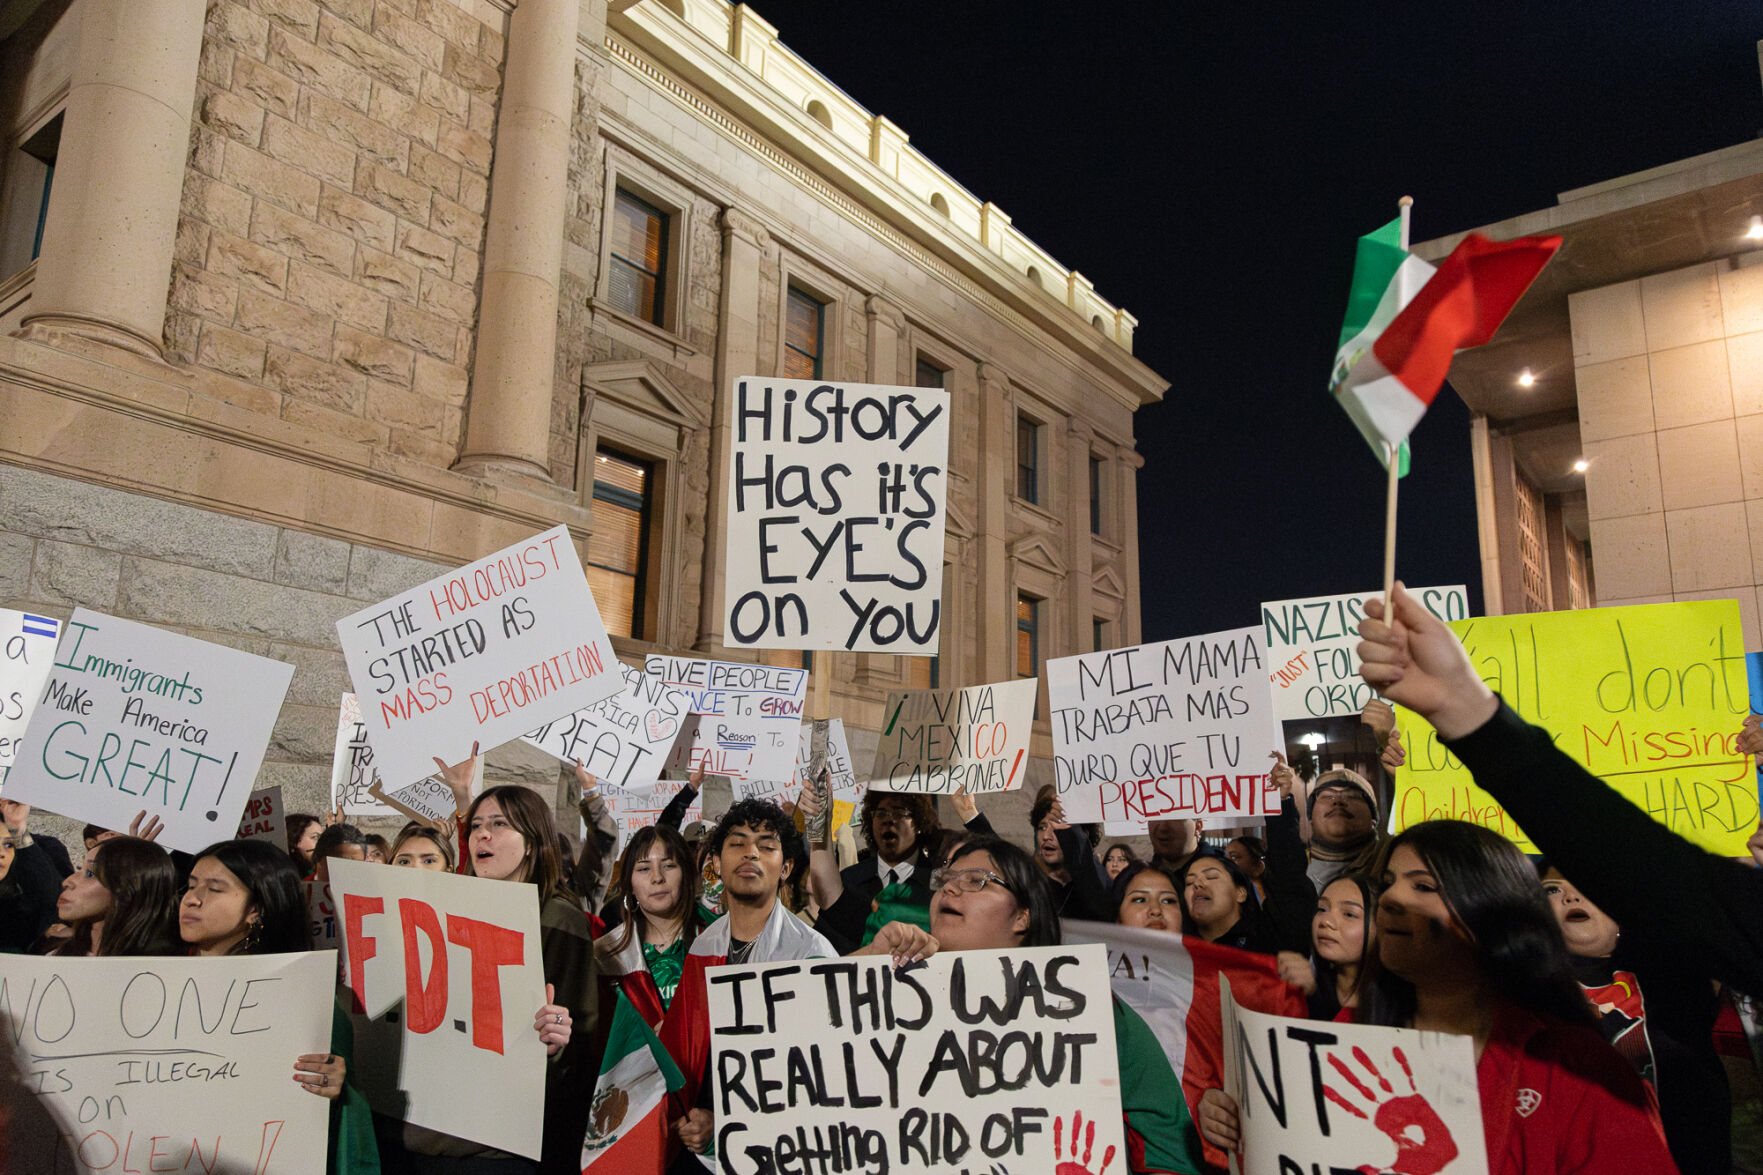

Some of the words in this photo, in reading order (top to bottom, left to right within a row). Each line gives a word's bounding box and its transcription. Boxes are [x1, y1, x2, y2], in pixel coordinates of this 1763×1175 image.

[736, 452, 852, 515] Has
[357, 600, 421, 647] THE
[430, 535, 561, 621] HOLOCAUST
[54, 622, 203, 705] Immigrants
[368, 619, 486, 694] STARTED
[501, 597, 535, 639] AS
[644, 658, 707, 684] GIVE
[713, 665, 793, 692] PEOPLE
[1078, 648, 1153, 701] MI
[1163, 634, 1262, 685] MAMA
[381, 672, 453, 729] MASS
[470, 641, 604, 725] DEPORTATION
[685, 690, 726, 714] NCE
[760, 697, 803, 715] GROW
[1051, 694, 1174, 745] TRABAJA
[1187, 685, 1250, 722] MÁS
[1305, 683, 1385, 717] ORD
[121, 697, 209, 746] America
[583, 700, 640, 735] RICA
[717, 724, 756, 742] Reason
[898, 721, 1008, 761] MEXICO
[42, 721, 239, 823] GREAT!
[411, 784, 433, 801] NOT
[1054, 753, 1118, 795] DURO
[1130, 742, 1187, 780] QUE
[1196, 734, 1240, 769] TU
[1099, 773, 1282, 821] PRESIDENTE
[1645, 777, 1759, 833] HARD
[0, 973, 75, 1046] NO
[120, 971, 282, 1039] ONE
[710, 965, 801, 1035] IF
[810, 957, 934, 1035] THIS
[949, 955, 1087, 1027] WAS
[32, 1068, 73, 1095] IS
[115, 1060, 241, 1086] ILLEGAL
[718, 1033, 907, 1116] REALLY
[919, 1029, 1098, 1099] ABOUT
[1236, 1020, 1339, 1138] NT
[899, 1107, 970, 1168] RID
[980, 1107, 1049, 1158] OF
